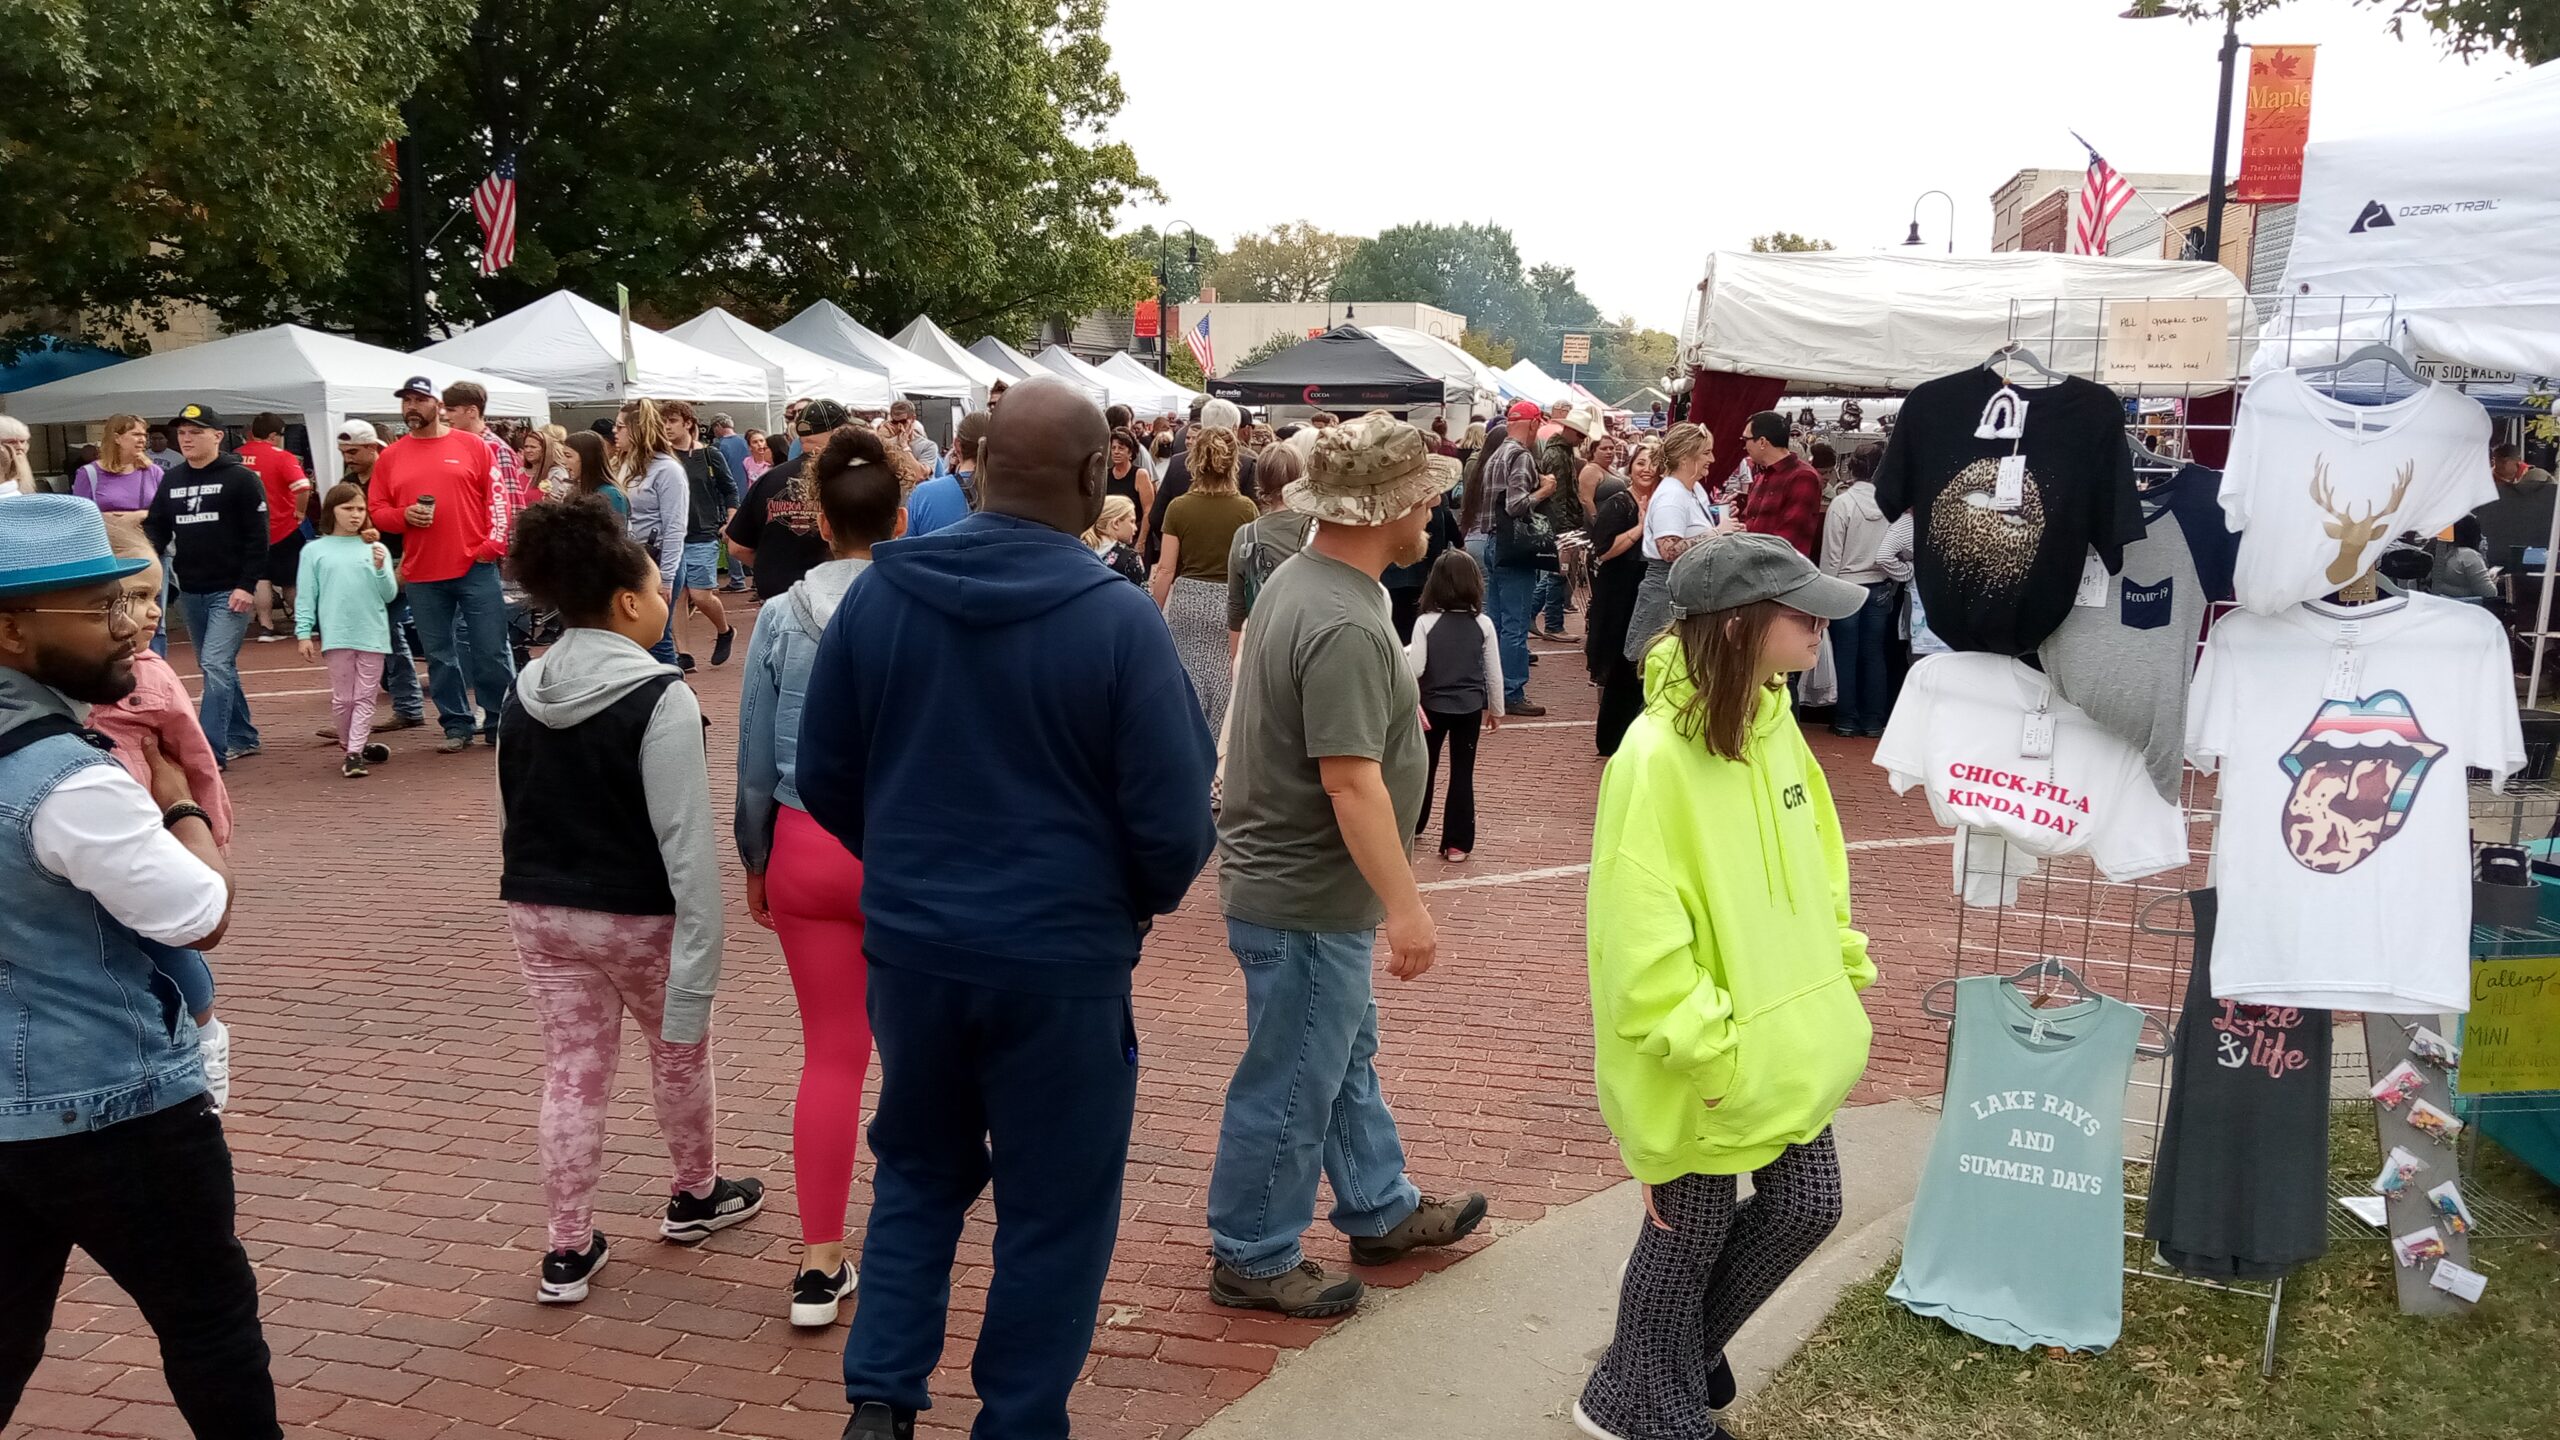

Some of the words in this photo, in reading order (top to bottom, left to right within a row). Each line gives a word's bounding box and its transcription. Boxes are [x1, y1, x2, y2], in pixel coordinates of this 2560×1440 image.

[2248, 85, 2311, 113] Maple
[2243, 146, 2299, 156] FESTIVA
[2399, 203, 2452, 217] OZARK
[2455, 199, 2500, 212] TRAIL
[2418, 365, 2436, 379] ON
[491, 482, 509, 543] Columbia
[2125, 587, 2169, 602] #COVID-19
[1949, 763, 2090, 814] CHICK-FIL-A
[1947, 788, 2026, 820] KINDA
[2031, 808, 2079, 836] DAY
[2474, 968, 2558, 1001] Calling
[2468, 1025, 2509, 1046] MINI
[2250, 1029, 2309, 1078] life
[1970, 1090, 2036, 1120] LAKE
[2041, 1093, 2101, 1136] RAYS
[2008, 1128, 2055, 1153] AND
[1959, 1154, 2044, 1185] SUMMER
[2050, 1168, 2102, 1195] DAYS
[715, 1196, 745, 1215] PUMA
